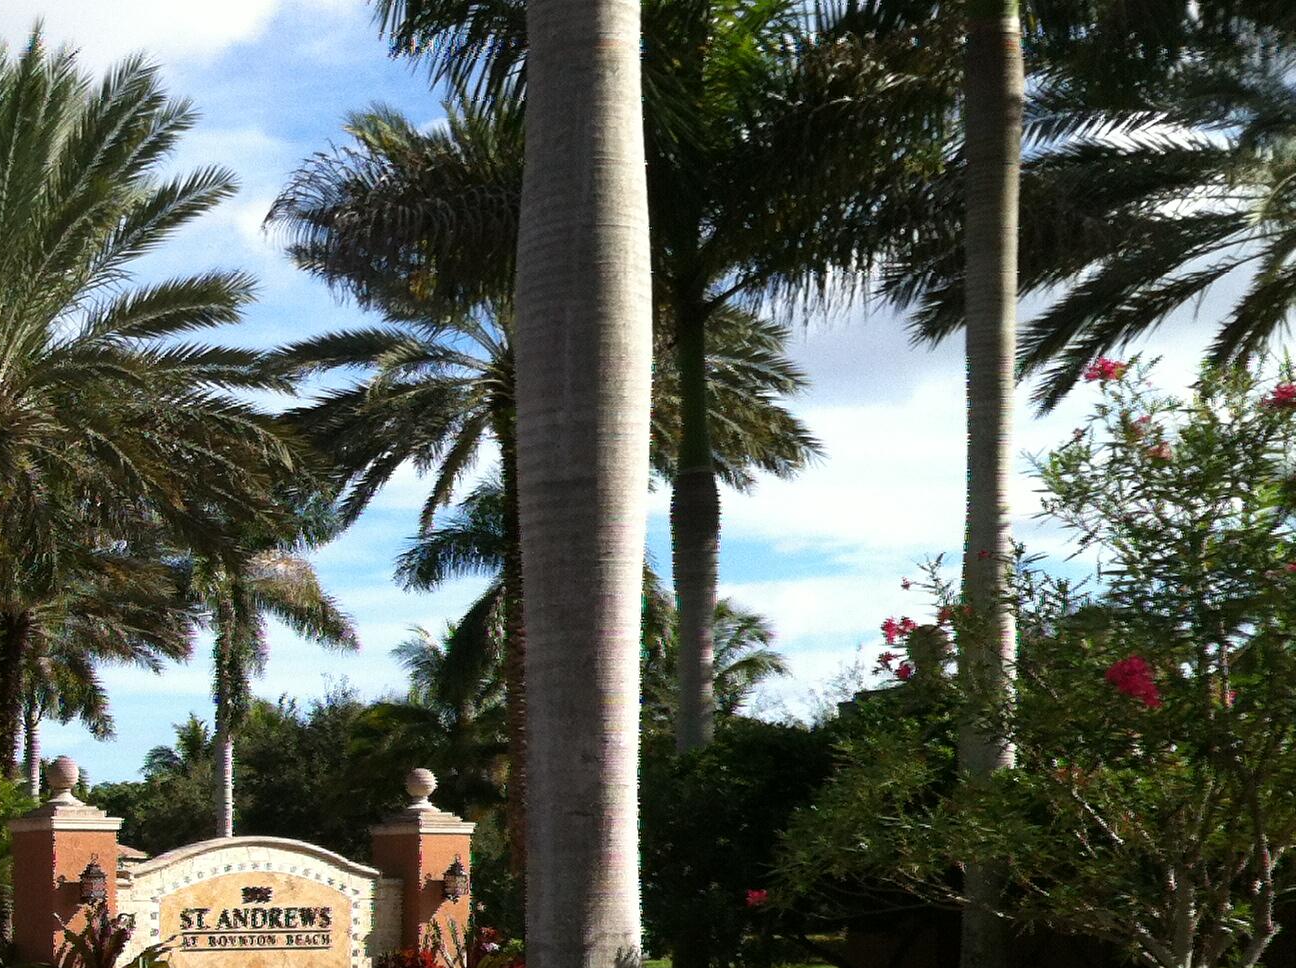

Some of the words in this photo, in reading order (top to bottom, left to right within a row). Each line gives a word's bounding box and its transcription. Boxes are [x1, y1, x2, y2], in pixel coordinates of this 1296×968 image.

[215, 907, 332, 930] ANDREWS
[182, 936, 198, 947] AT
[208, 934, 276, 947] BOYNTON
[286, 934, 331, 946] BEACH
